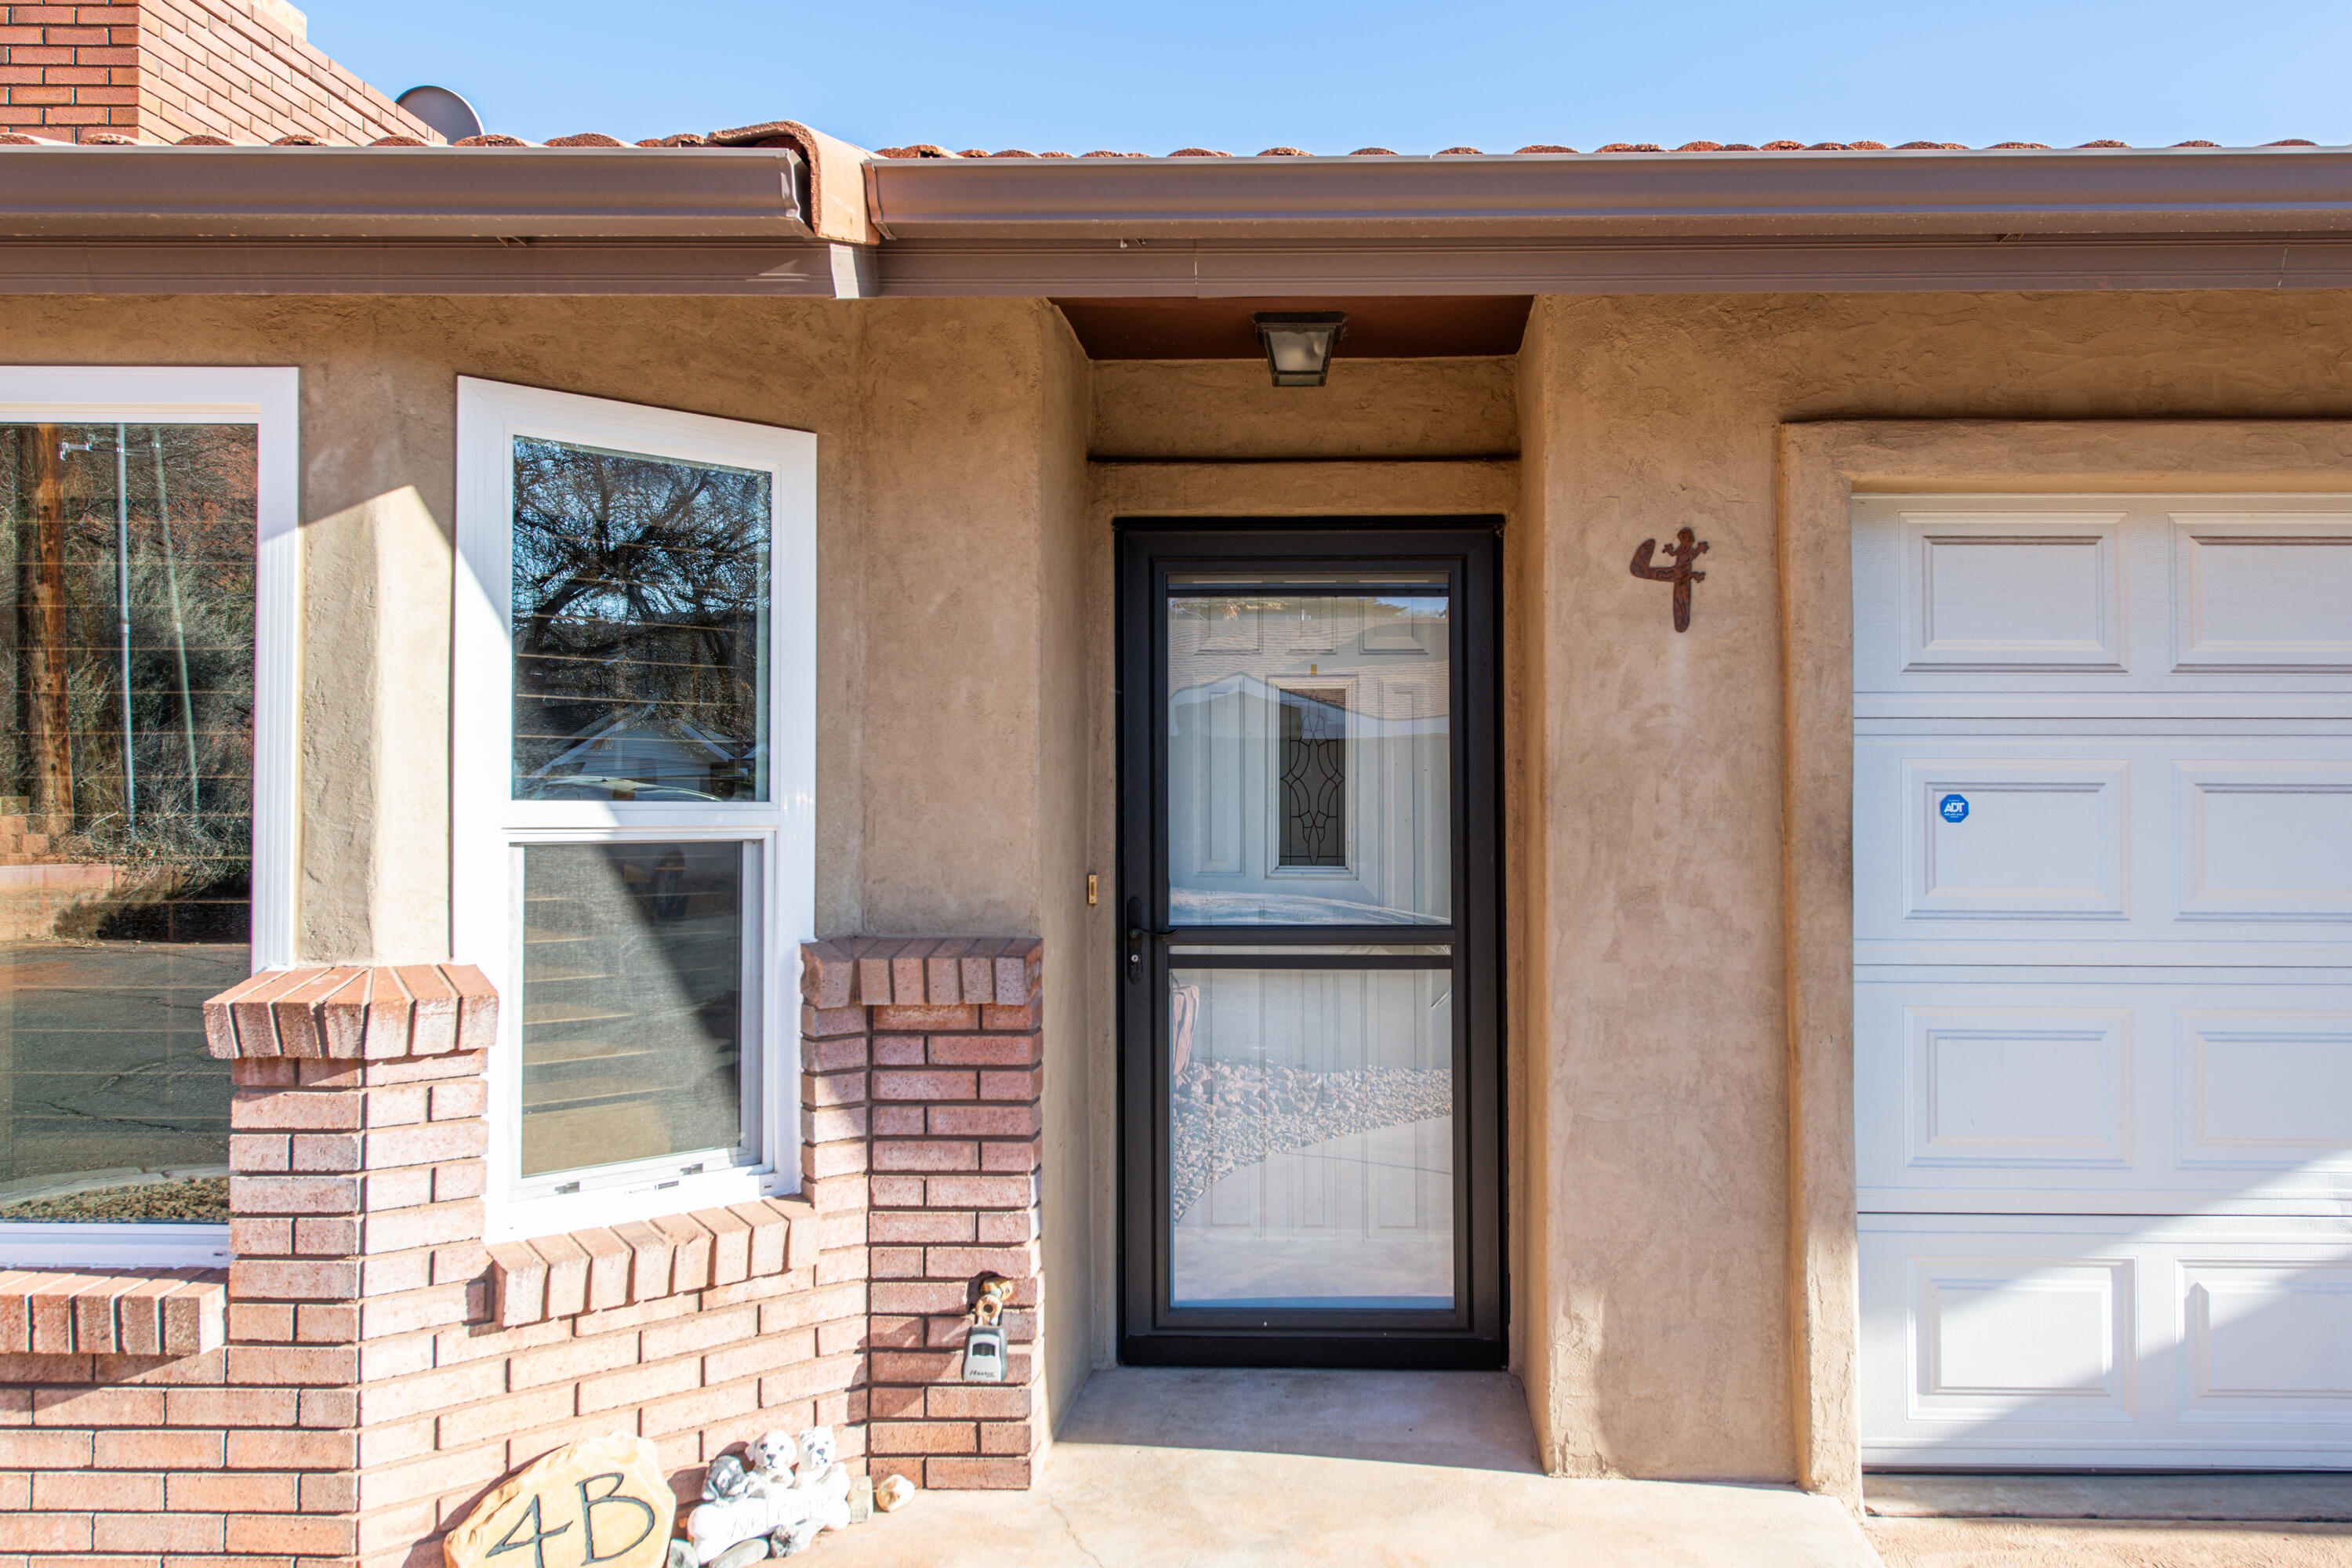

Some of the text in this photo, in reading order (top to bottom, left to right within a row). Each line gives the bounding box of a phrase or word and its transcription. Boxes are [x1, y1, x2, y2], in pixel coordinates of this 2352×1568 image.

[1630, 527, 1709, 633] 4
[1944, 803, 1965, 812] ADT
[485, 1472, 655, 1568] 4B
